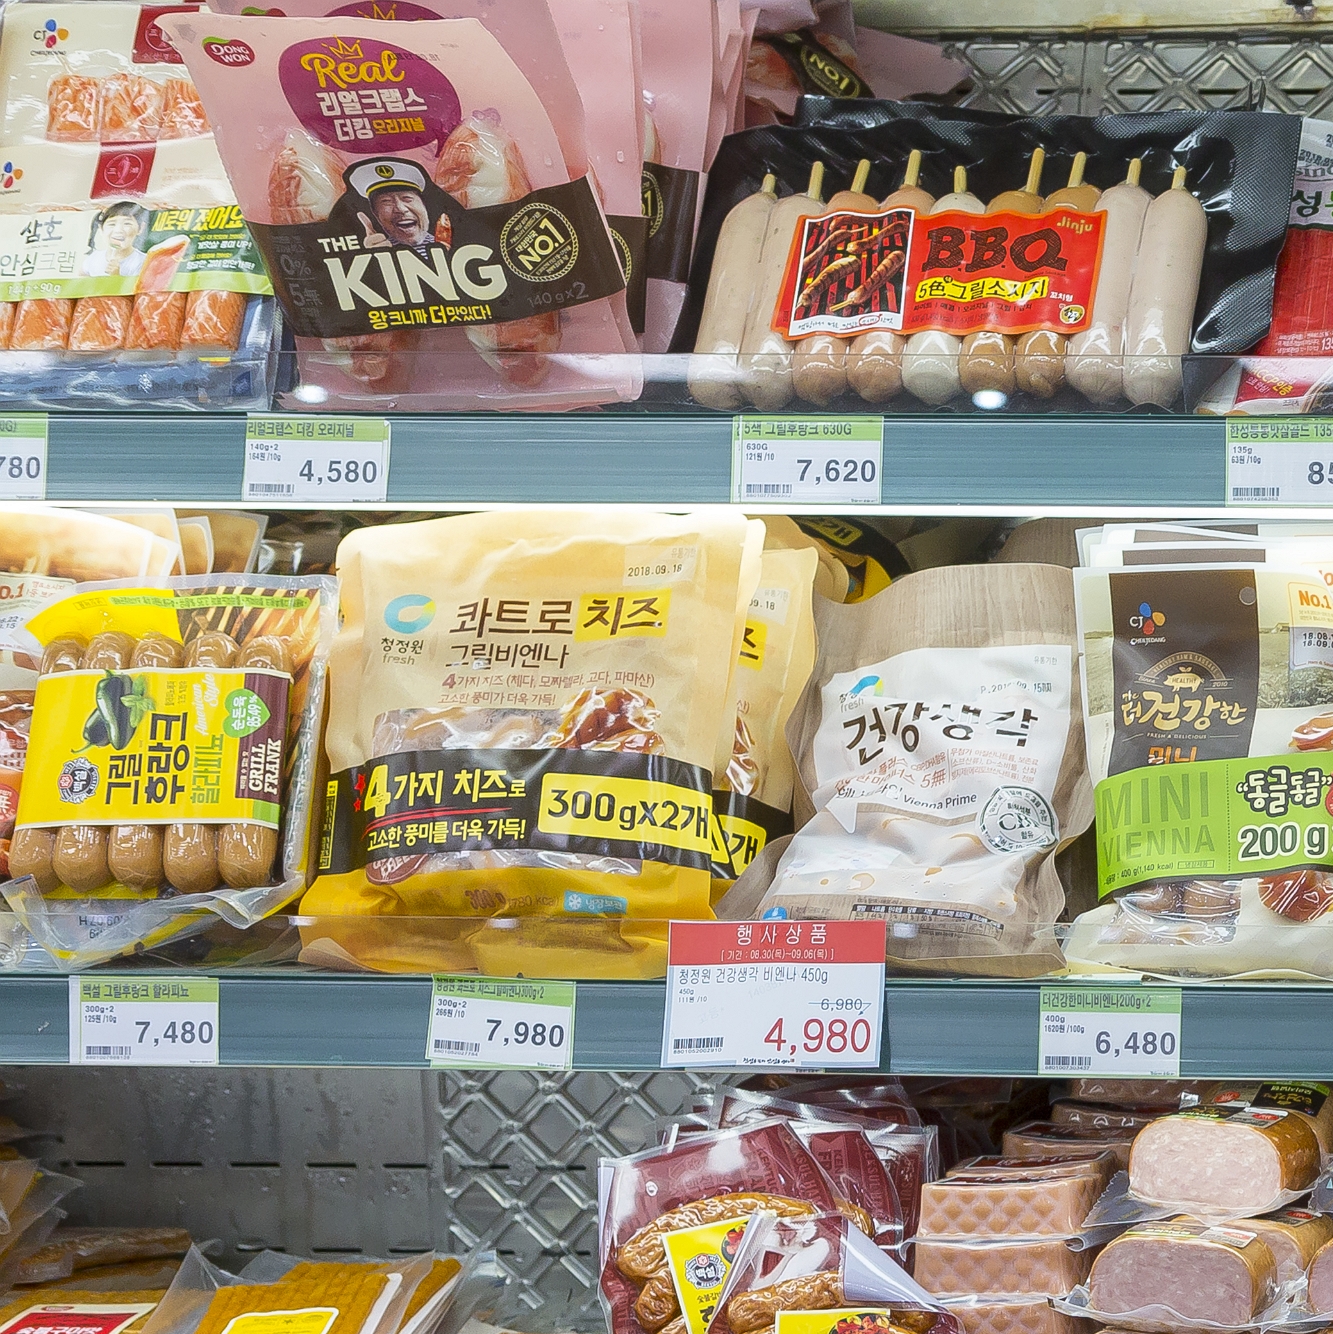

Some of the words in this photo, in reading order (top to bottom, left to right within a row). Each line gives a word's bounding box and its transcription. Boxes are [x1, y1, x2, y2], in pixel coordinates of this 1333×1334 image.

[302, 47, 404, 88] Real
[317, 89, 427, 117] 리얼크랩스
[318, 235, 358, 253] THE
[324, 243, 510, 312] KING
[1234, 446, 1252, 454] 135g
[300, 460, 376, 485] 4,580
[797, 460, 875, 485] 7,620
[449, 597, 574, 639] 콰트로
[583, 596, 664, 635] 치즈
[445, 643, 570, 671] 그릴비엔나
[843, 700, 1039, 768] 건강생각
[363, 766, 443, 819] 4가지
[453, 768, 527, 803] 치즈로
[1103, 773, 1212, 828] MINI
[367, 822, 404, 849] 고소한
[404, 820, 449, 846] 풍미를
[452, 819, 484, 842] 더욱
[487, 816, 527, 842] 가득!
[1103, 821, 1216, 869] VIENNA
[680, 969, 710, 984] 청정원
[717, 967, 758, 983] 건강생각
[764, 967, 796, 981] 비엔나
[801, 968, 827, 984] 450g
[83, 984, 100, 998] 백설
[105, 984, 149, 998] 그릴후랑크
[821, 999, 862, 1012] 6,980
[1045, 1015, 1065, 1023] 400g
[136, 1021, 213, 1046] 7,480
[487, 1019, 564, 1047] 7,980
[764, 1018, 870, 1055] 4,980
[1096, 1032, 1175, 1057] 6,480
